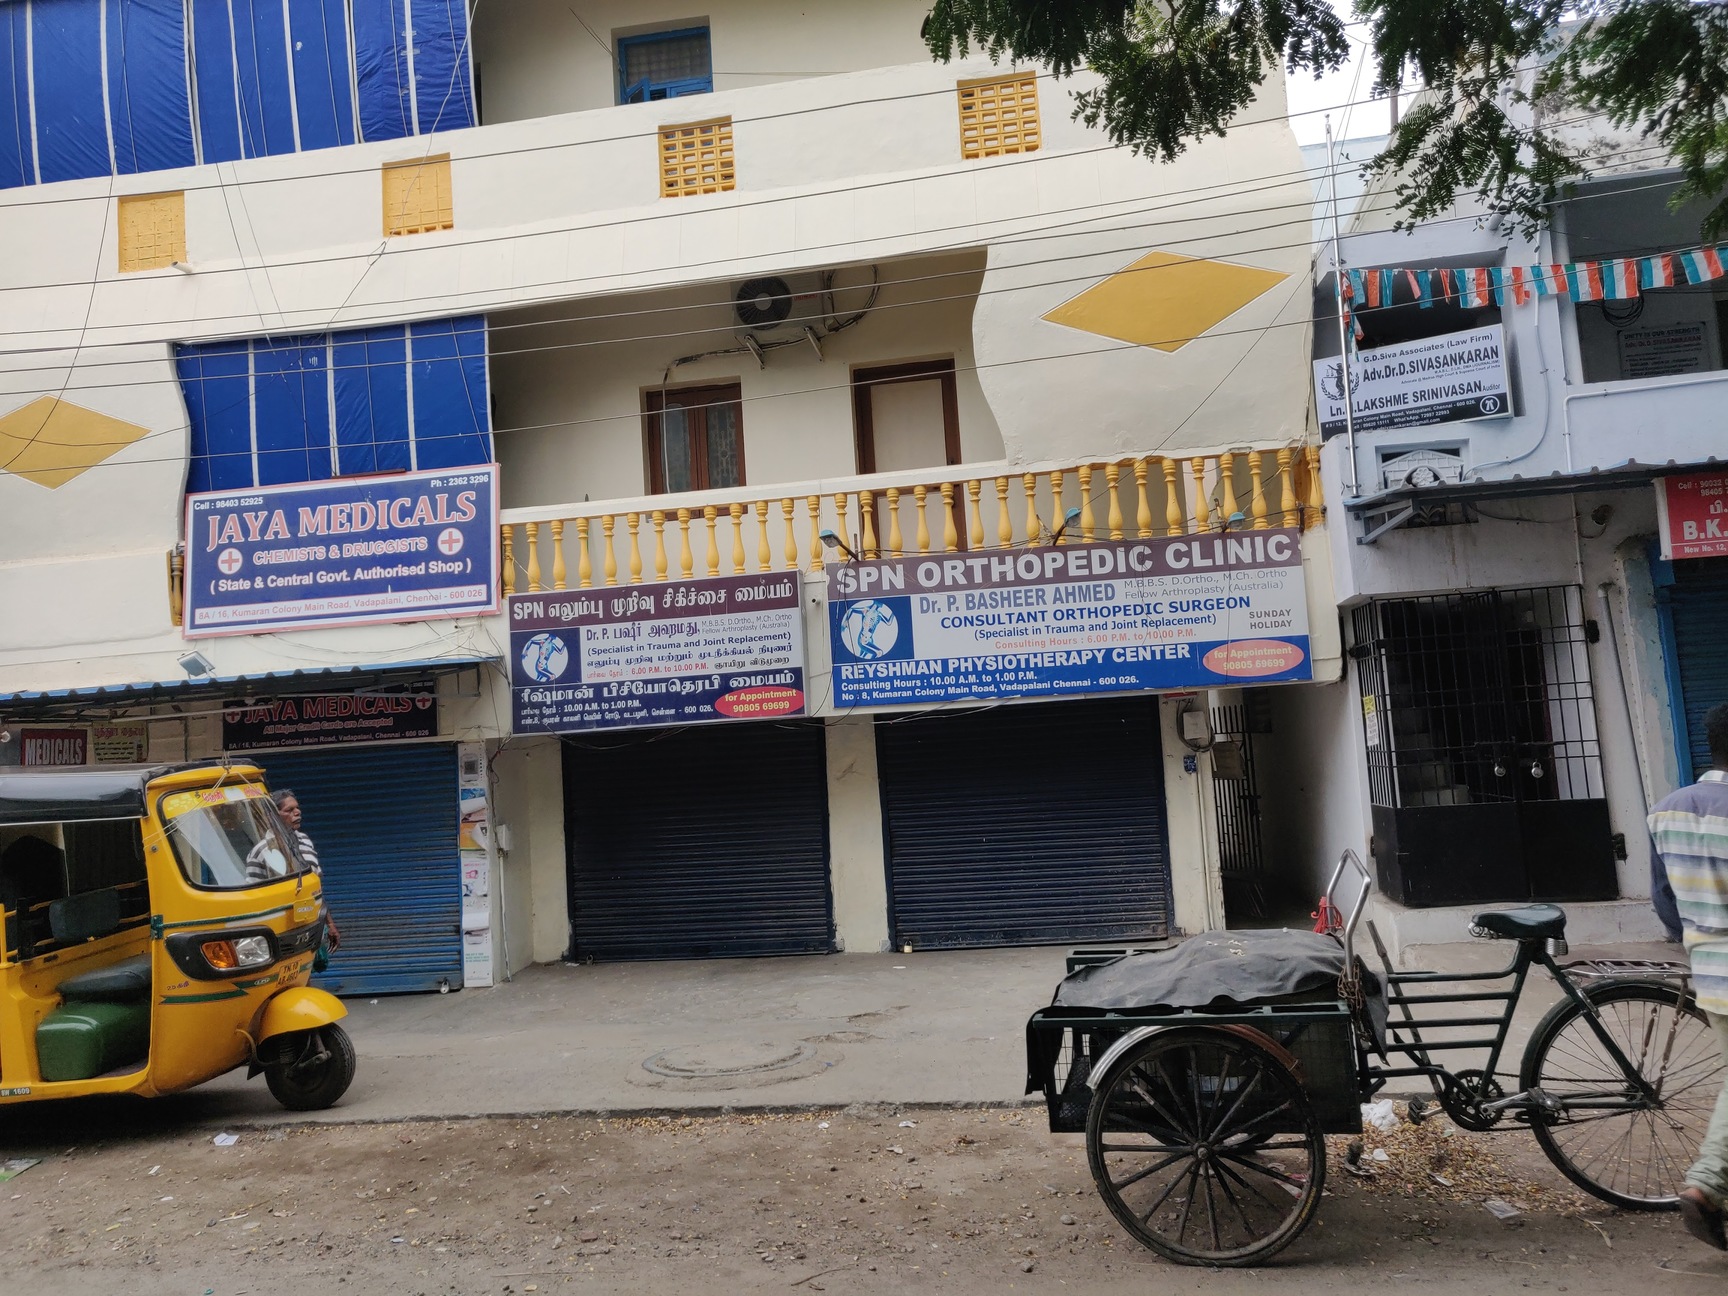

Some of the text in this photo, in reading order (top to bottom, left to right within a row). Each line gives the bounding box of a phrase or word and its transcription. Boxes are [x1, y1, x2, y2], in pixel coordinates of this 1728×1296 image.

[1364, 333, 1493, 363] G.D.Siva Associates (Law Firm)
[1363, 345, 1499, 382] Adv.Dr.D.SIVASANKARAN
[1330, 380, 1500, 417] Ln..LAKSHME SRINIVASAN Auditor
[430, 475, 489, 488] Ph 2362 3296
[1678, 482, 1692, 490] Cell
[194, 497, 263, 511] Cell 98403 52925
[206, 491, 476, 552] JAYA MEDICALS
[253, 537, 428, 565] CHEMISTS & DRUGGISTS
[1684, 546, 1700, 554] New
[836, 534, 1292, 594] SPN ORTHOPEDIC CLINIC
[218, 560, 463, 592] State & Central Govt. Authorised Shop
[1124, 578, 1167, 588] M.B.B.S.
[1223, 572, 1252, 581] M.Ch.
[1257, 569, 1288, 578] Ortho
[920, 583, 1116, 614] Dr. P. BASHEER AHMED
[1125, 580, 1284, 599] Fellow Arthroplasty (Australia)
[232, 590, 482, 618] Kumaran Colony Main Road, Vadapalani, Chennai 600 026
[514, 578, 793, 621] SPN எலும்பு முறிவு சிகிச்சை மையம்
[941, 596, 1250, 628] CONSULTANT ORTHOPEDIC SURGEON
[1249, 609, 1292, 618] SUNDAY
[586, 629, 598, 640] Dr.
[602, 628, 609, 640] P.
[722, 624, 758, 634] Arthroplasty
[974, 614, 1216, 641] (Specialist in Trauma and Joint Replacement)
[1250, 620, 1292, 630] HOLIDAY
[588, 643, 634, 656] (Specialist
[647, 642, 681, 651] Trauma
[684, 640, 700, 648] and
[703, 636, 725, 646] Joint
[728, 632, 791, 645] Replacement)
[995, 638, 1046, 648] Consulting
[1050, 636, 1078, 646] Hours
[1088, 634, 1108, 644] 6.00
[1112, 633, 1130, 642] P.M.
[1134, 632, 1144, 640] to
[1178, 628, 1196, 637] P.M.
[587, 658, 620, 668] எலும்பு
[658, 650, 693, 662] மற்றும்
[841, 644, 1191, 680] REYSHMAN PHYSIOTHERAPY CENTER
[1214, 646, 1292, 659] for Appointment
[648, 666, 662, 674] P.M.
[674, 664, 692, 672] 10.00
[695, 662, 708, 670] P.M.
[1256, 658, 1284, 668] 69699
[730, 670, 794, 688] மையம்
[842, 671, 1037, 691] Consulting Hours 10.00 A.M. to 1.00 P.M.
[873, 690, 912, 699] Kumaran
[915, 688, 945, 697] Colony
[948, 686, 969, 694] Main
[972, 684, 997, 692] Road,
[1000, 681, 1050, 692] Vadapalani
[1053, 679, 1090, 688] Chennai
[1099, 677, 1116, 685] 600
[1119, 676, 1139, 684] 026.
[725, 688, 796, 702] for Appointment
[244, 693, 412, 724] JAYA MEDICALS
[564, 704, 582, 712] 10.00
[584, 702, 600, 711] A.M.
[628, 700, 641, 708] P.M.
[733, 701, 790, 712] 90805 69699
[274, 724, 296, 734] Major
[297, 722, 320, 731] Credit
[320, 720, 343, 730] Cards
[358, 717, 393, 728] Accepted
[26, 738, 82, 765] MEDICALS
